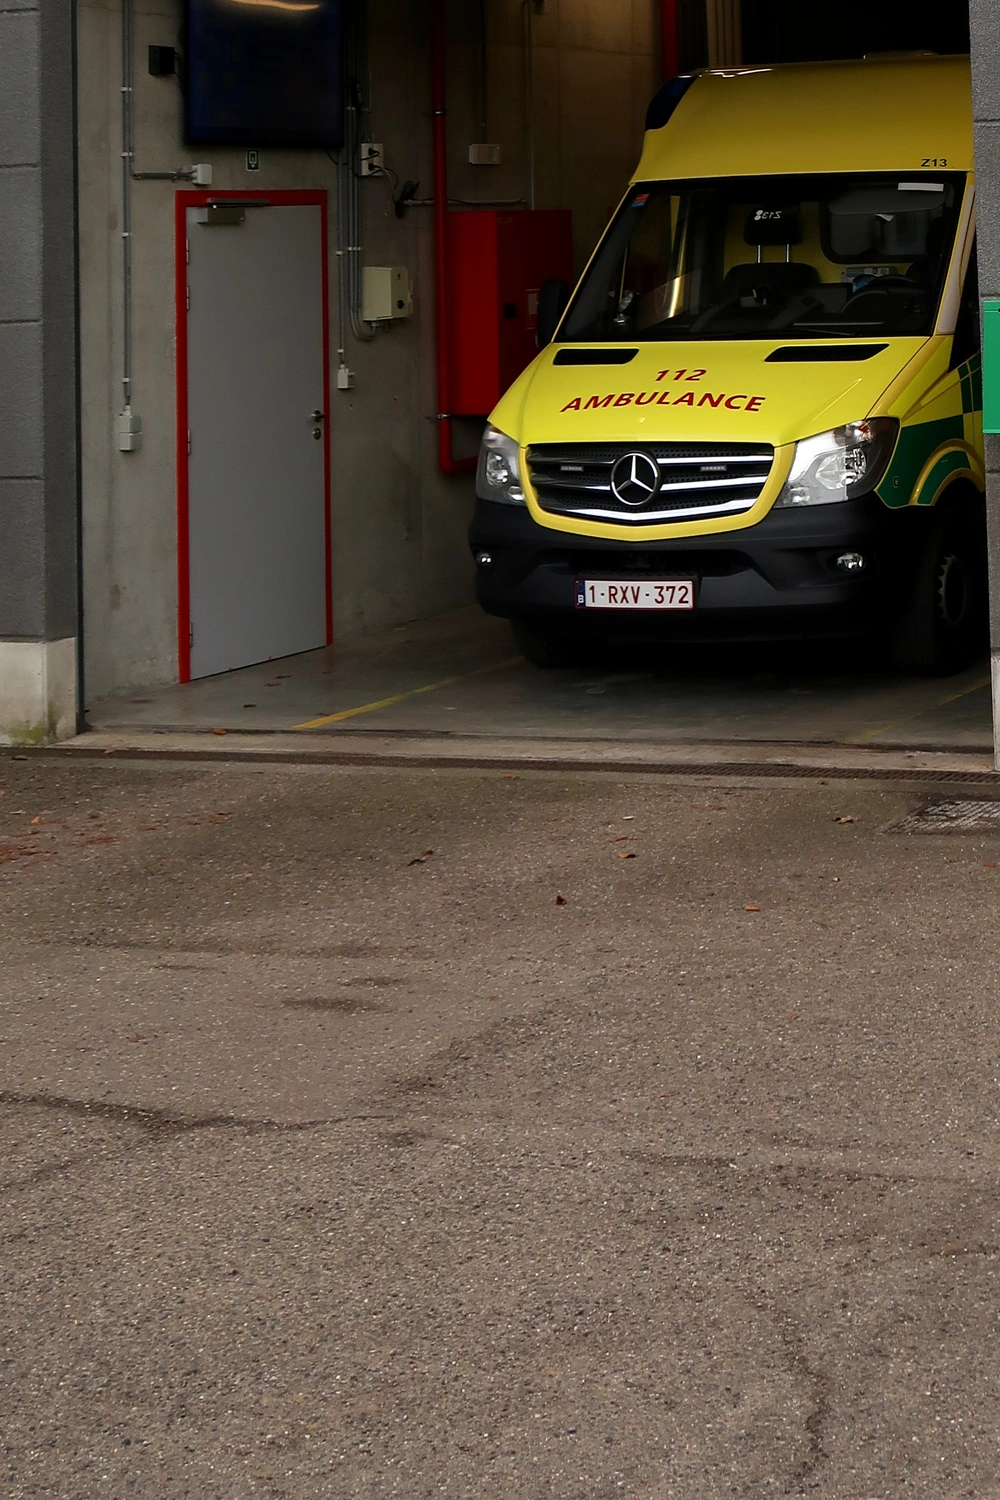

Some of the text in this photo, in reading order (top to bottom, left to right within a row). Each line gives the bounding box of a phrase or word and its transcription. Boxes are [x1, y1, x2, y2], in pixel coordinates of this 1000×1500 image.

[920, 158, 948, 168] Z13
[655, 368, 708, 382] 112
[559, 391, 767, 413] AMBULANCE
[577, 594, 585, 604] B
[588, 584, 690, 605] 1-RXV-372
